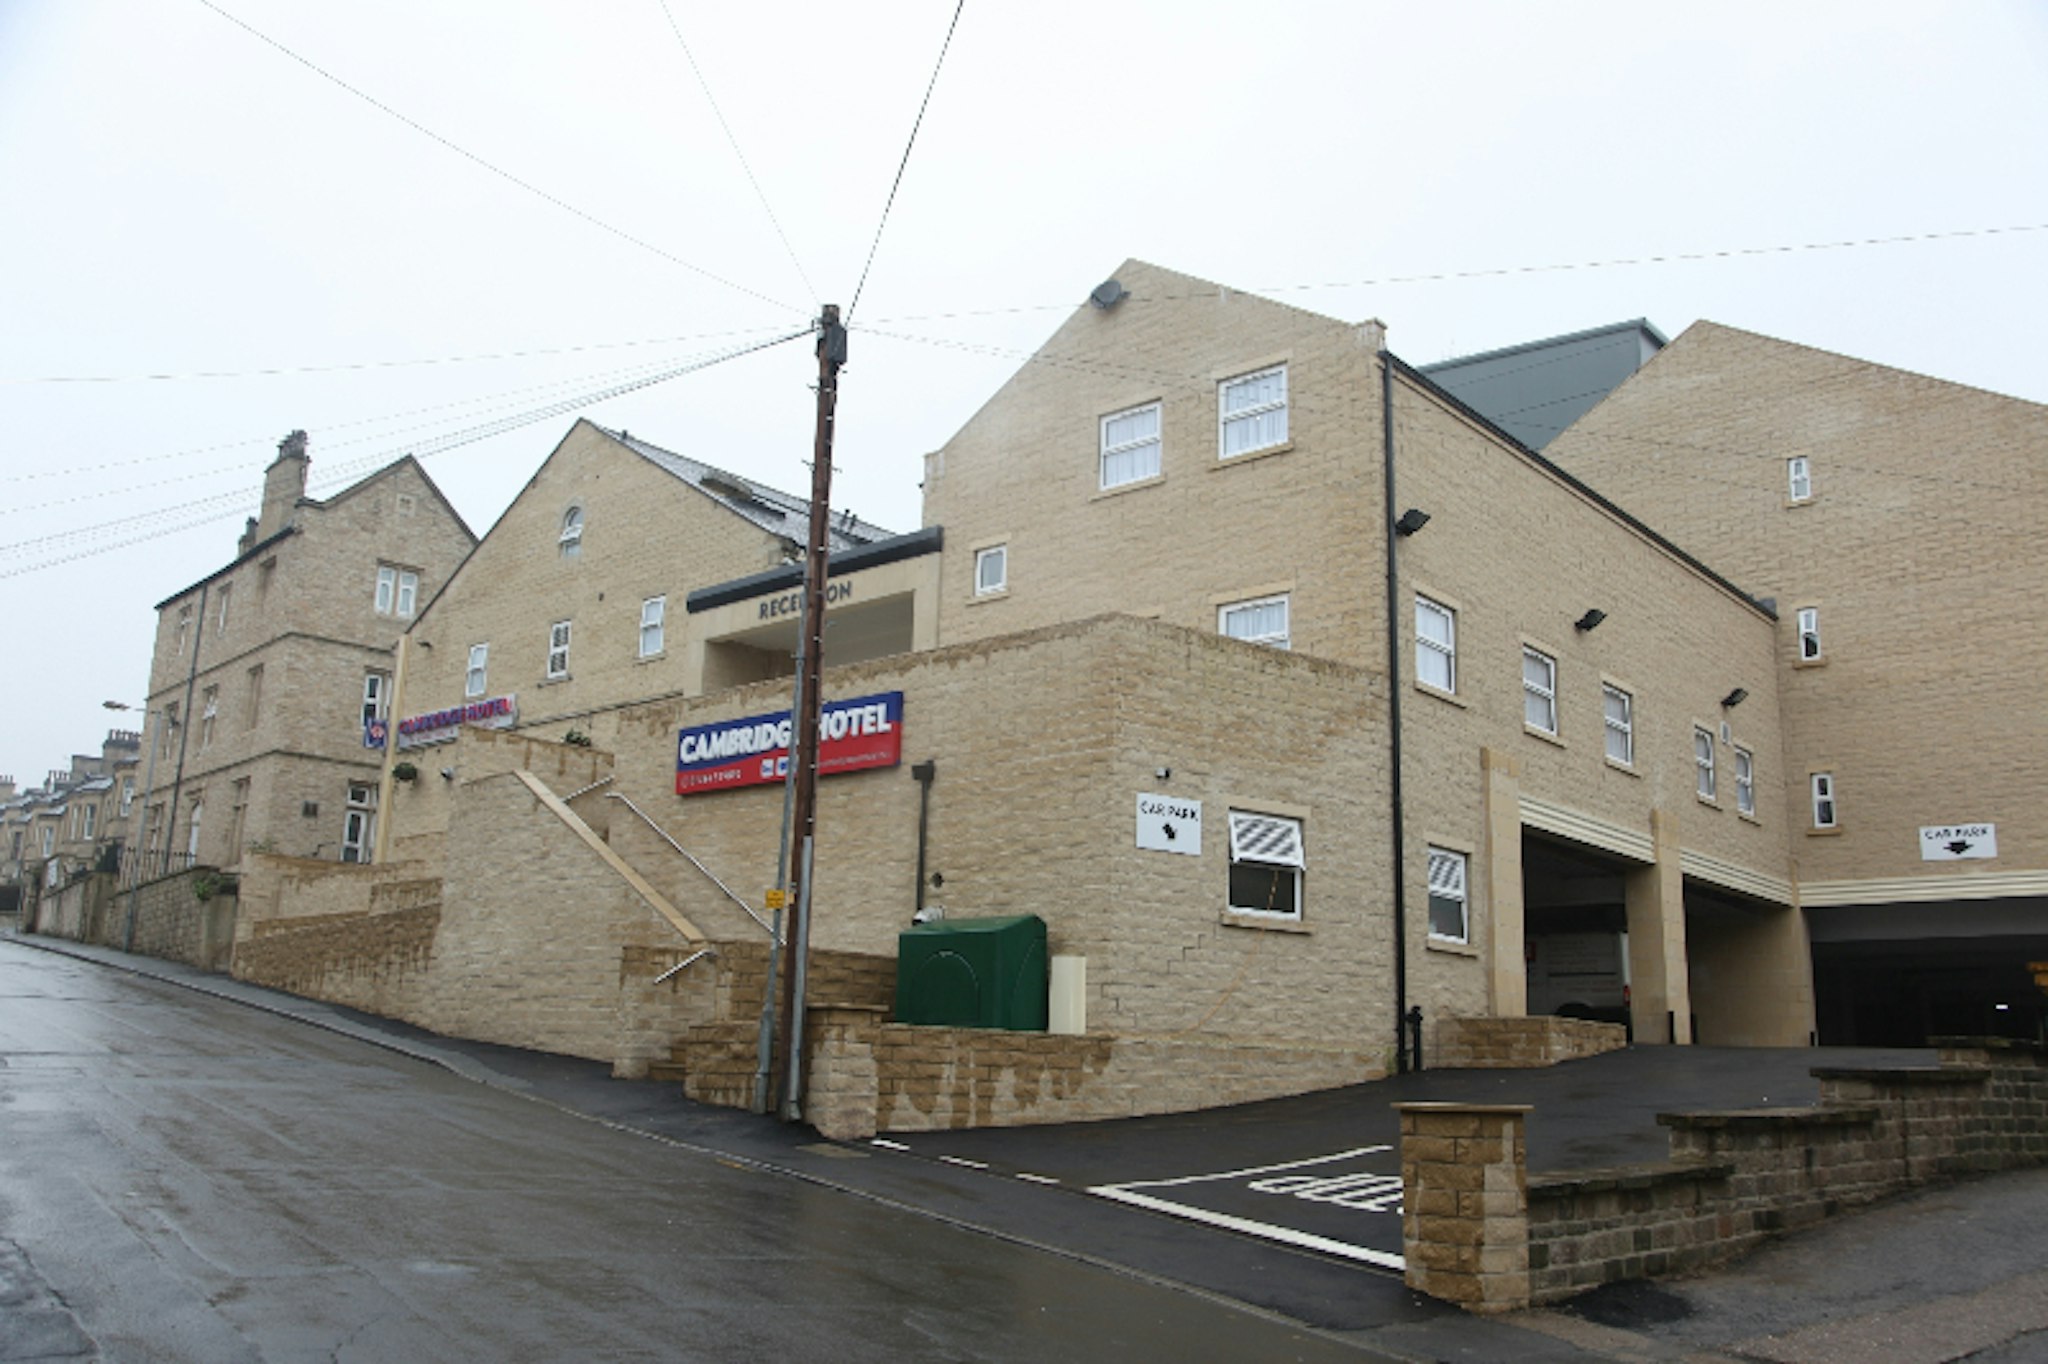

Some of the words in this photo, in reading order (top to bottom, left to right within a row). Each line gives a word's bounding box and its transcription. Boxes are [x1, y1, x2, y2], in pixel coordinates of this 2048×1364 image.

[759, 580, 852, 621] RECEON
[680, 719, 799, 763] CAMBRIDG
[1955, 825, 1988, 838] PARK
